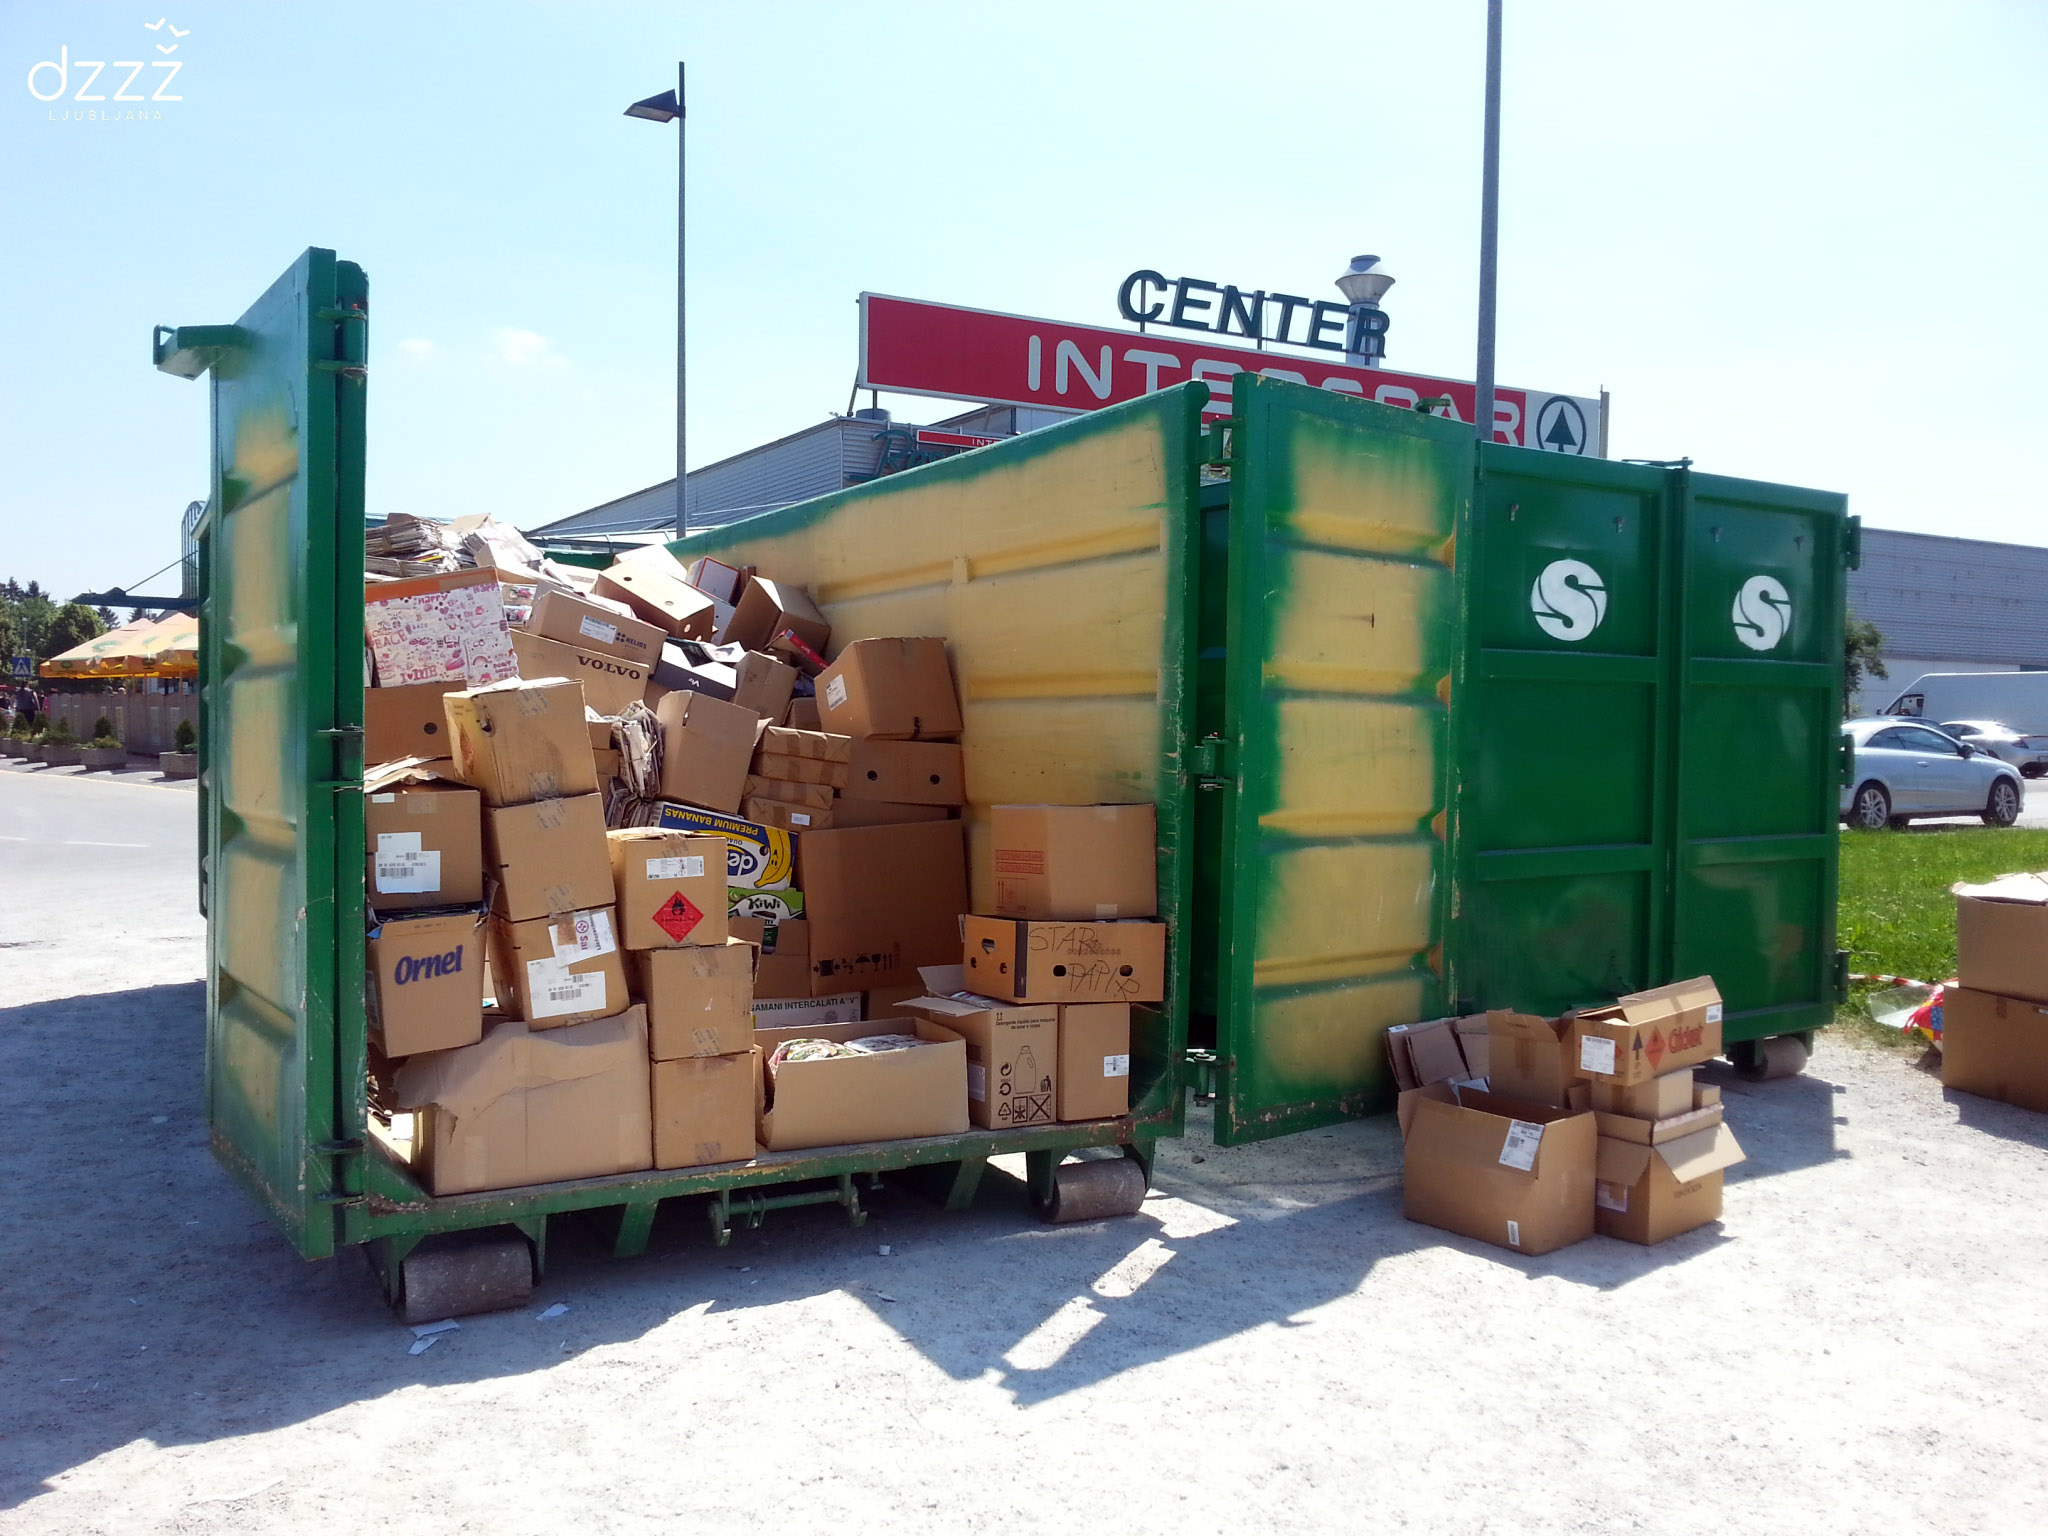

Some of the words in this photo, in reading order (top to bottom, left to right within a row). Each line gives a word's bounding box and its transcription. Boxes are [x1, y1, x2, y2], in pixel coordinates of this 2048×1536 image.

[1117, 269, 1390, 358] CENTER
[626, 636, 647, 650] HELIOS
[576, 655, 641, 680] VOLVO
[664, 807, 713, 826] BANANAS
[713, 819, 759, 836] PREMIUM
[1029, 926, 1098, 956] STAR
[394, 944, 464, 985] Ornel
[785, 998, 838, 1010] INTERCALATI
[837, 997, 845, 1005] A
